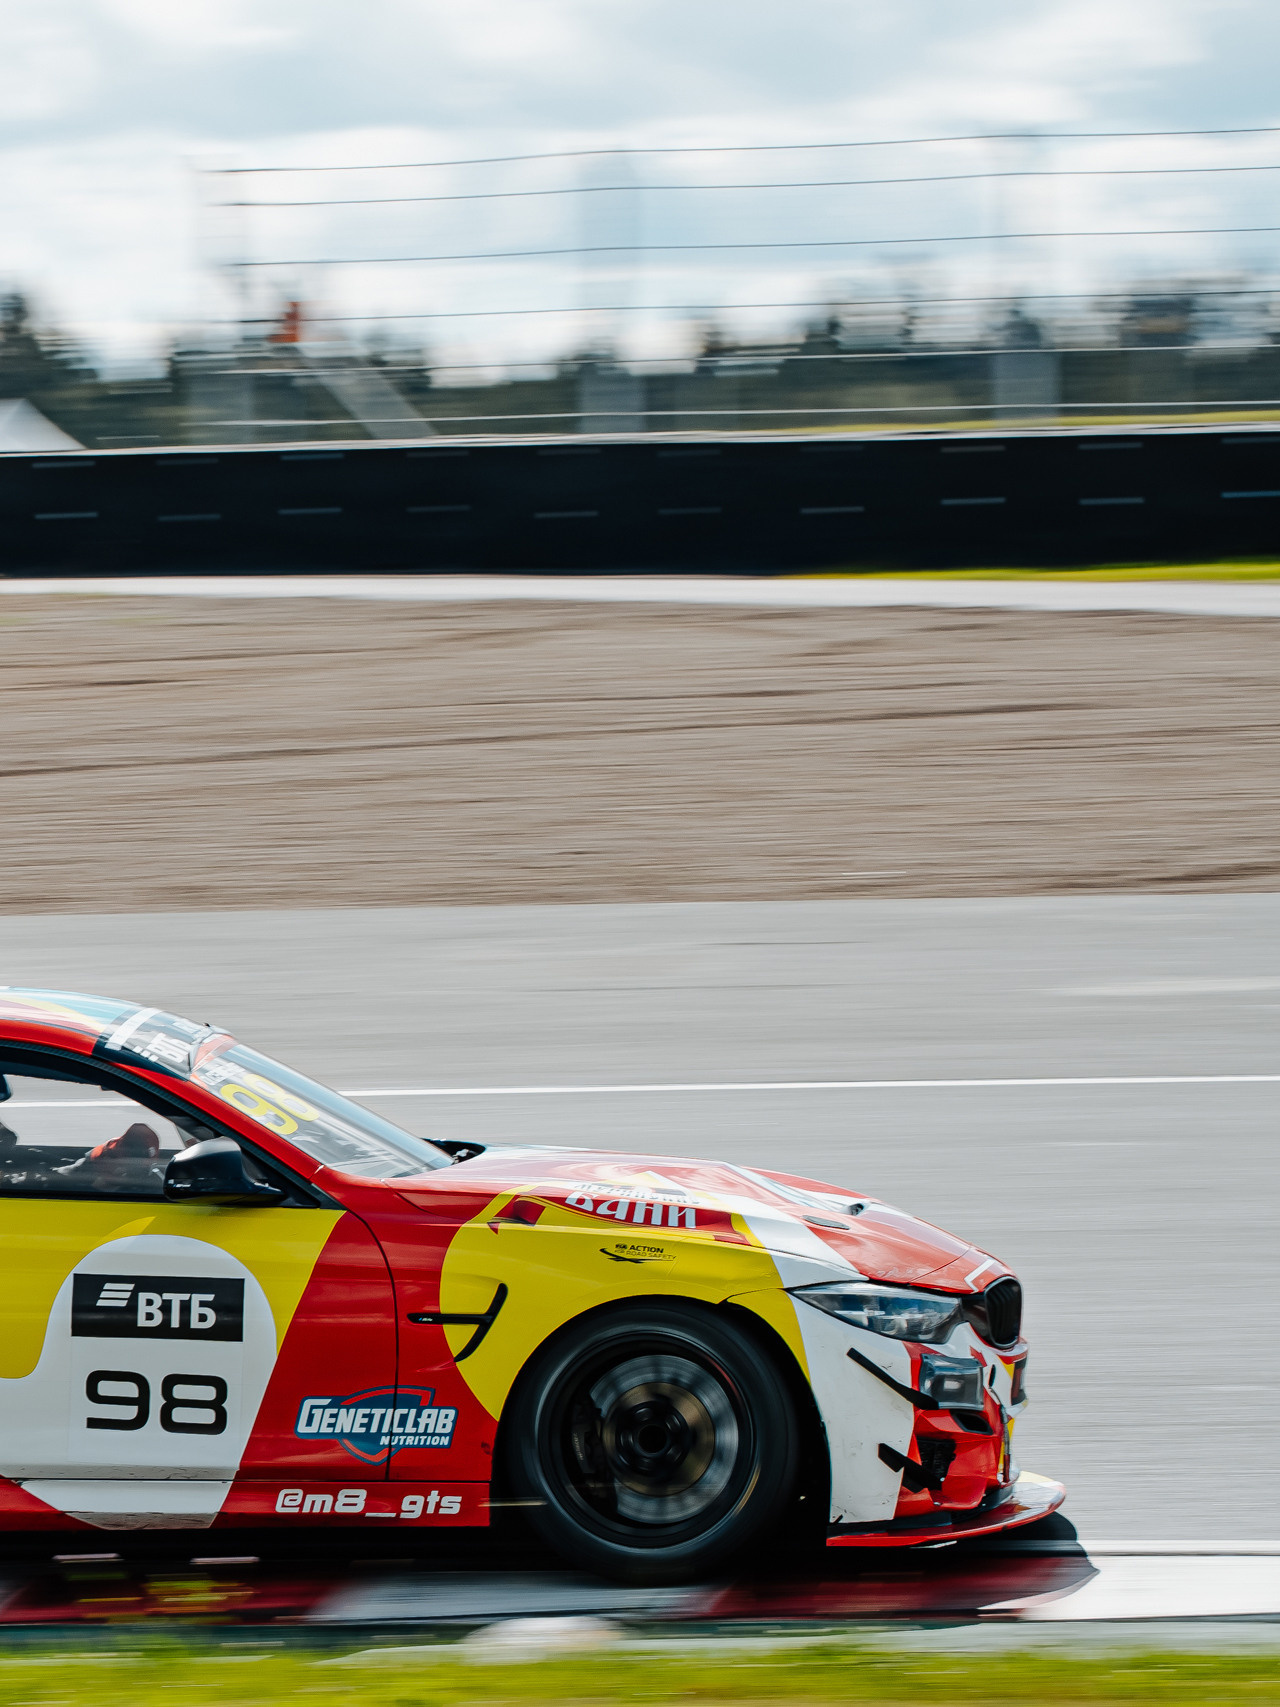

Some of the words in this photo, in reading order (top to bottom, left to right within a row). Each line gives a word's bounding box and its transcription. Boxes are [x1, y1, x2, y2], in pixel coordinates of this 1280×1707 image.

[219, 1072, 320, 1135] 98
[628, 1244, 664, 1254] ACTION
[648, 1252, 677, 1260] SAFETY
[136, 1292, 217, 1329] ВТБ
[85, 1369, 228, 1436] 98
[379, 1435, 450, 1446] NUTRITION
